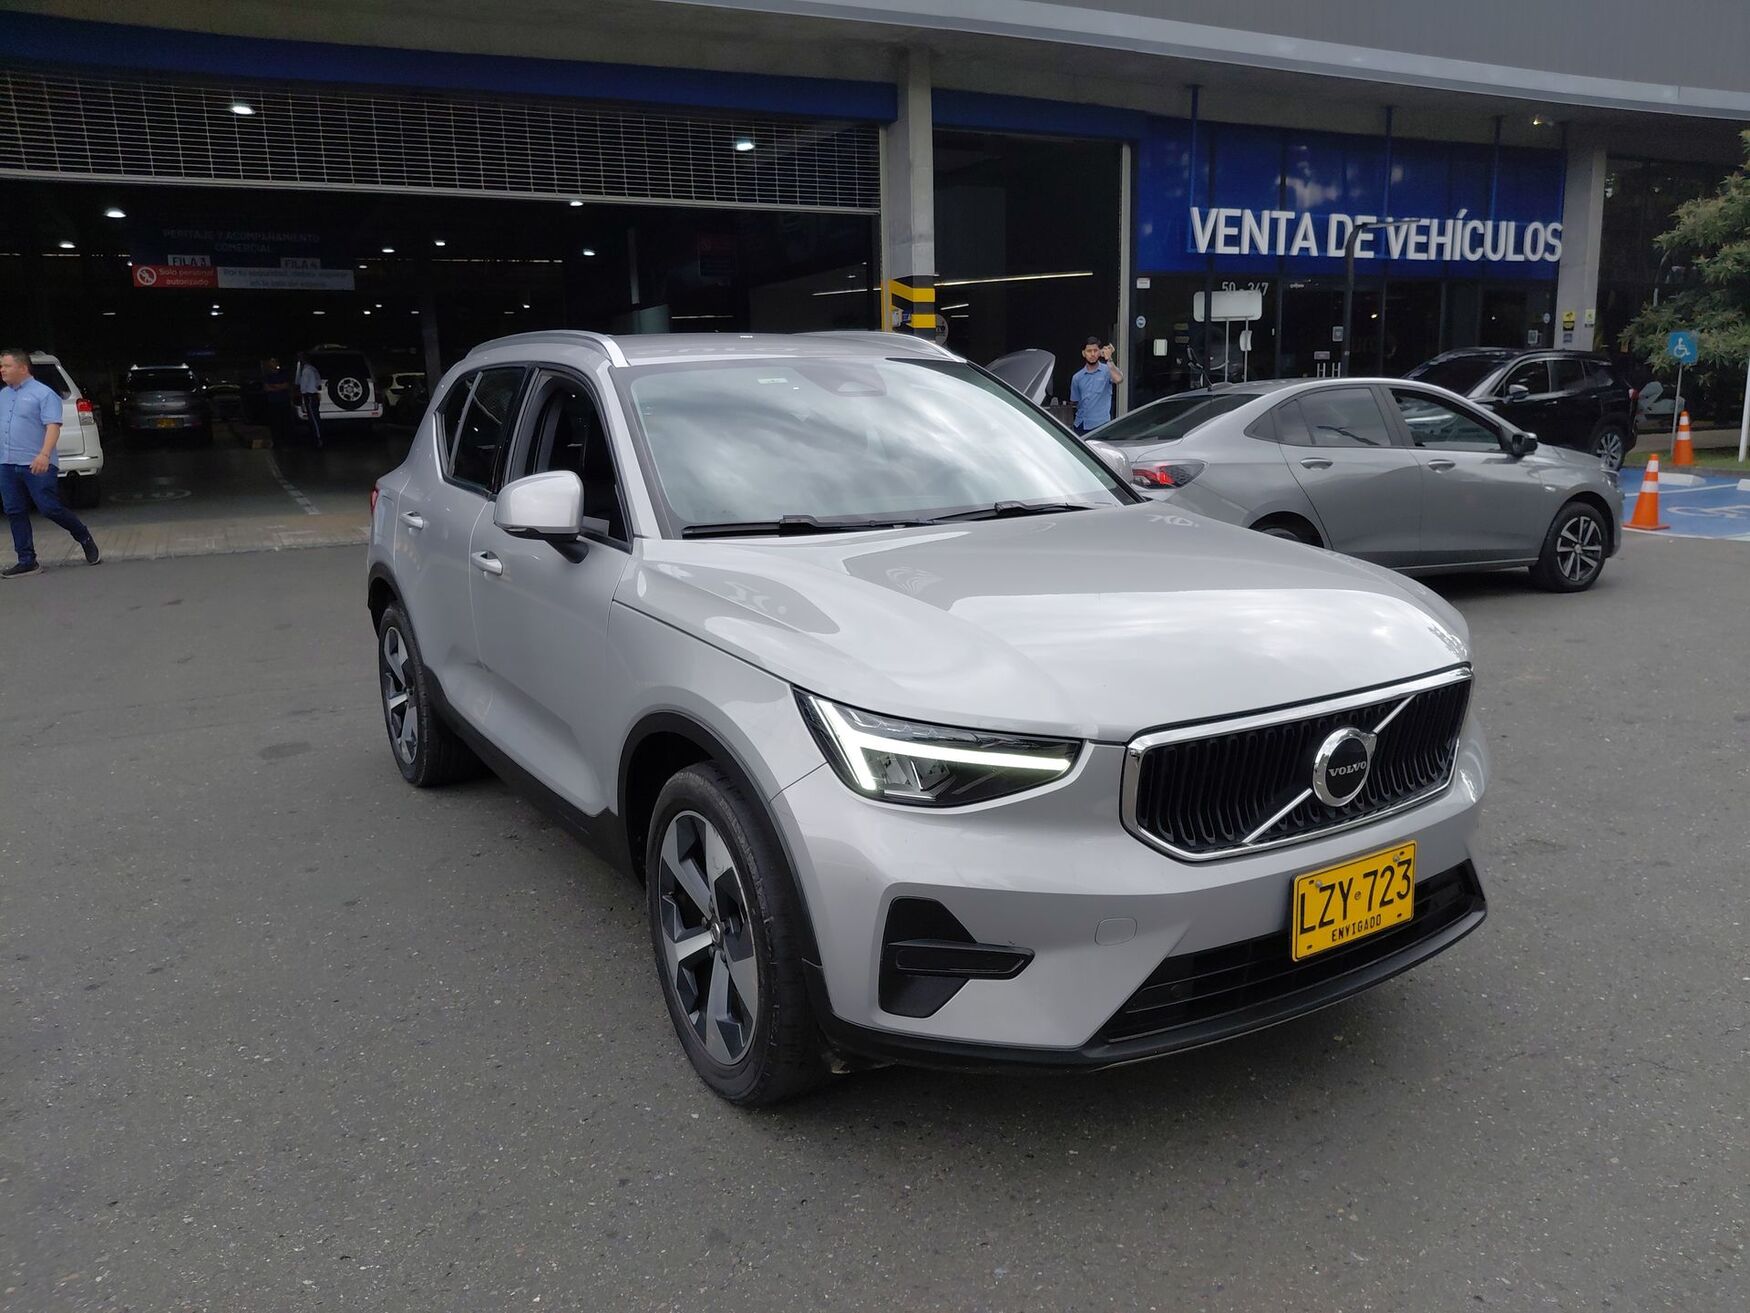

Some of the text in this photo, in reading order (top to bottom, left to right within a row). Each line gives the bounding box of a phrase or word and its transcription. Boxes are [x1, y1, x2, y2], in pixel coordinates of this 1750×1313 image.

[1189, 207, 1564, 262] VENTA DE VEHÍCULOS
[172, 256, 198, 267] FILA
[285, 259, 309, 269] FILA
[1328, 760, 1367, 777] VOLVO
[1331, 913, 1382, 943] ENVIGADO
